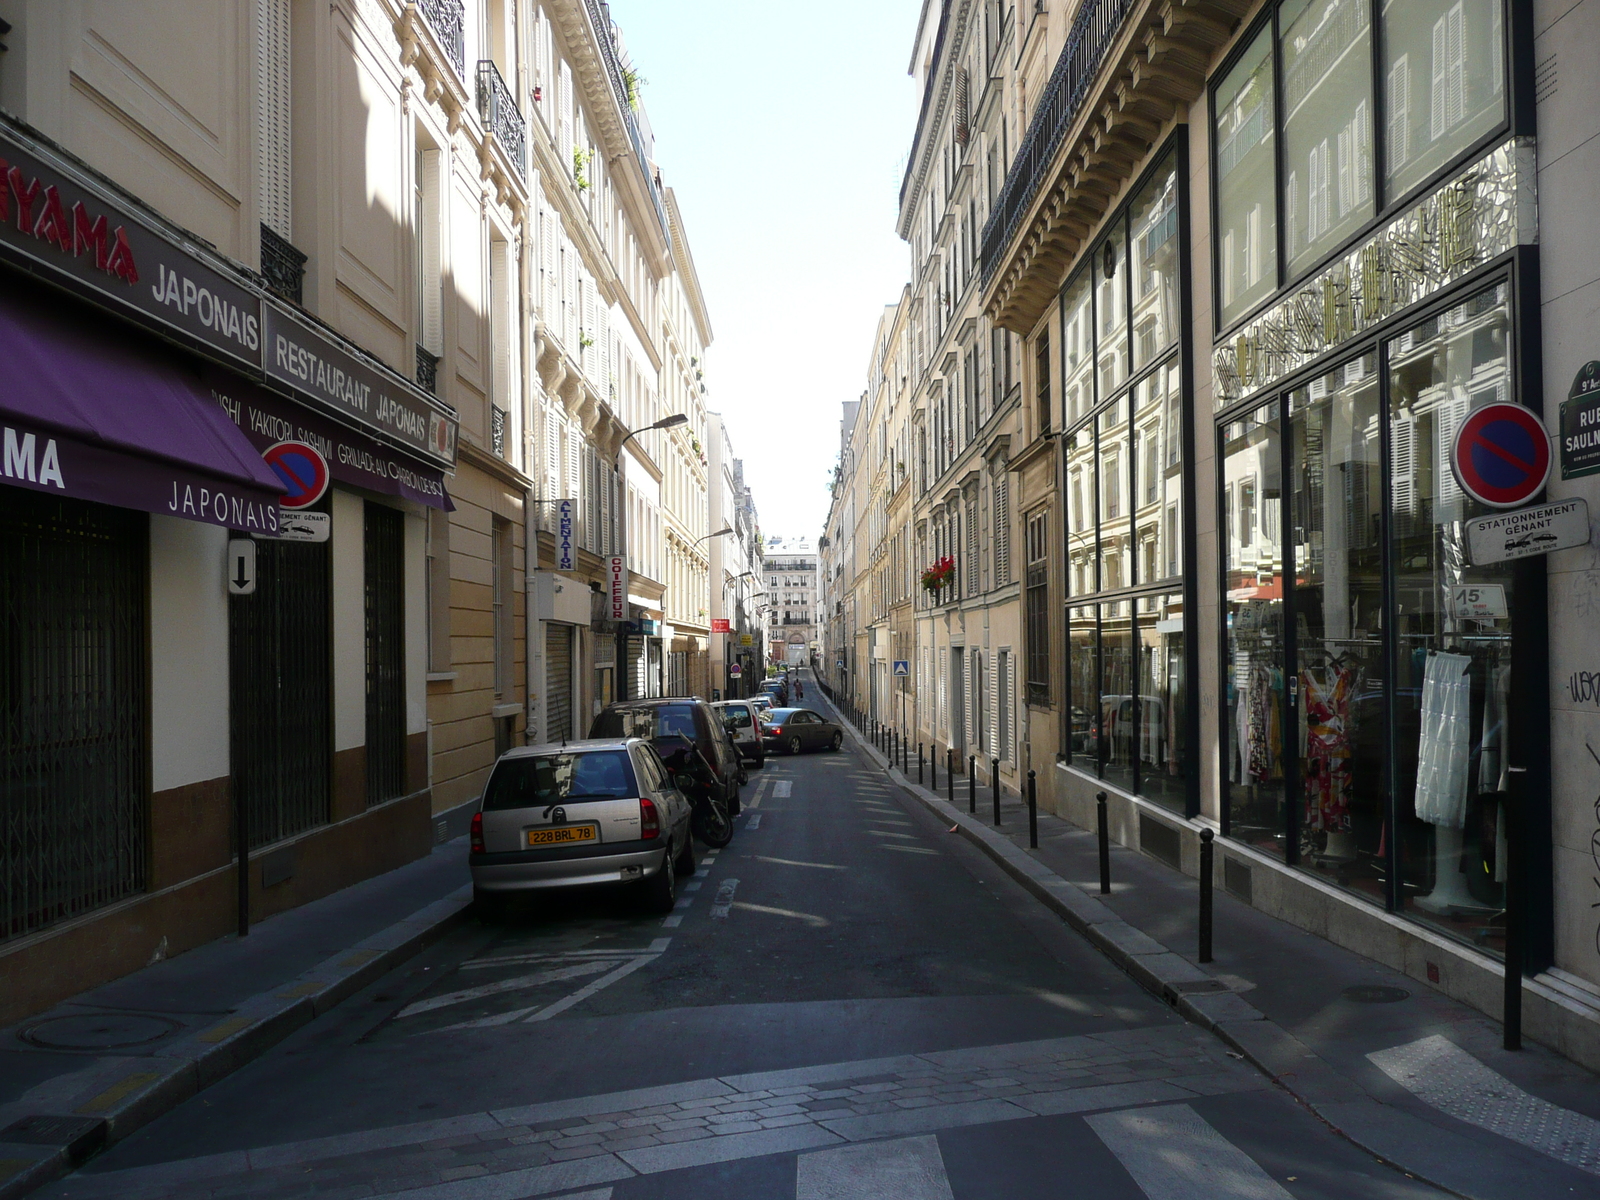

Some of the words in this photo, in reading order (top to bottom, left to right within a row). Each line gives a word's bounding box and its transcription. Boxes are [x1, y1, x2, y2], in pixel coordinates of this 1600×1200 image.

[0, 158, 139, 286] YAMA
[152, 263, 259, 351] JAPONAIS
[276, 334, 371, 413] RESTAURANT
[376, 394, 425, 442] JAPONAIS
[248, 406, 293, 441] YAKITORI
[297, 427, 333, 460] SASHIMI
[337, 443, 376, 474] GRILLADE
[376, 458, 387, 478] AU
[0, 427, 65, 489] MA
[169, 481, 277, 532] JAPONAIS
[304, 514, 327, 522] GÊNANT
[560, 501, 571, 570] ALIMENTATION
[1478, 503, 1576, 531] STATIONNEMENT
[1505, 518, 1552, 536] GÊNANT
[611, 558, 622, 619] COIFFEUR
[533, 831, 554, 843] 228
[554, 829, 575, 841] BRL
[576, 828, 591, 839] 78
